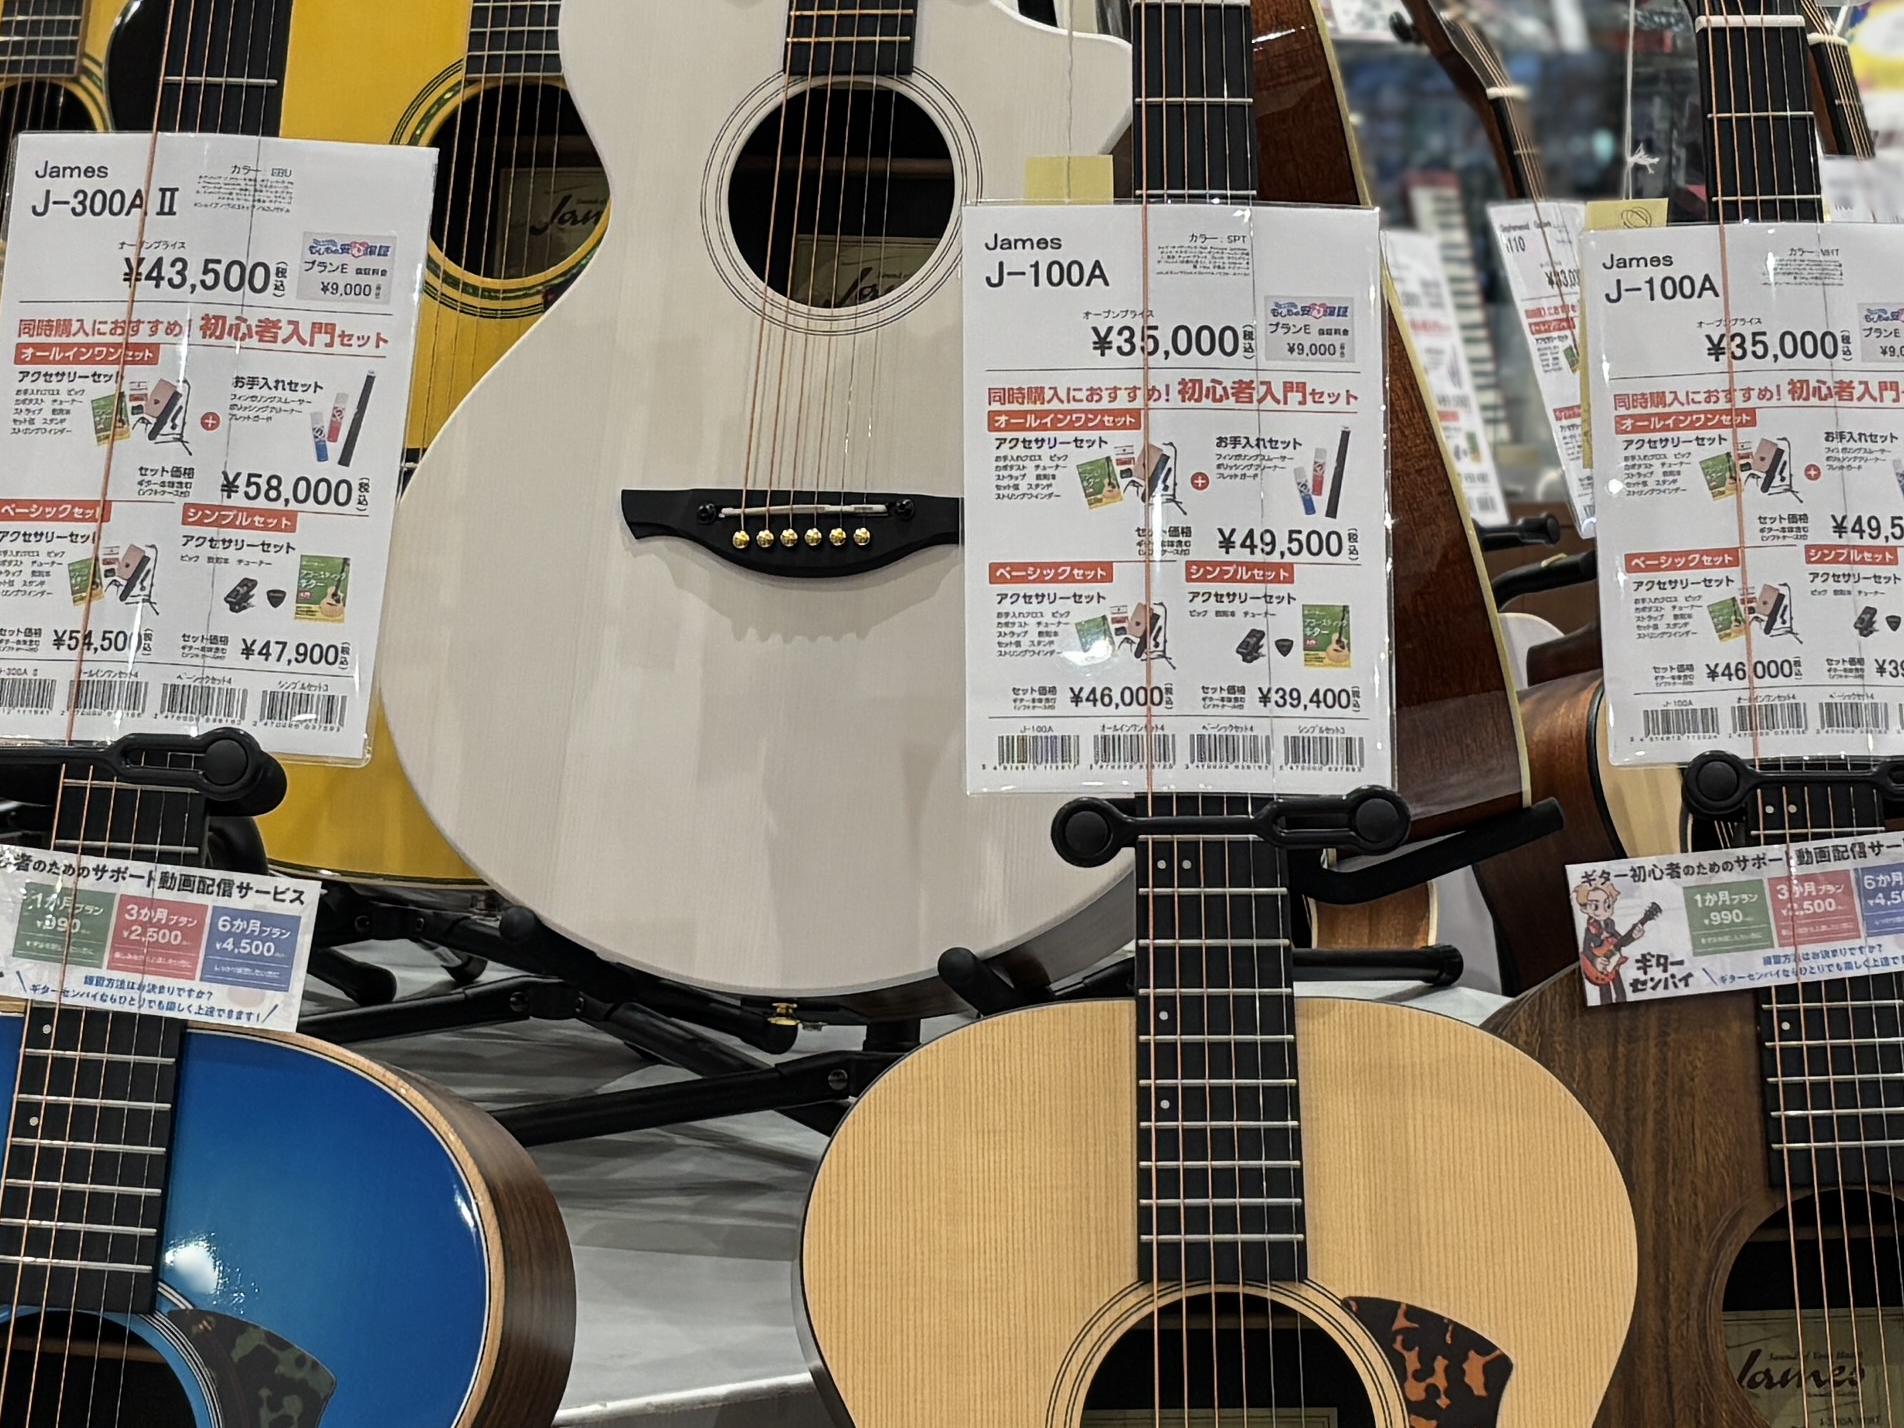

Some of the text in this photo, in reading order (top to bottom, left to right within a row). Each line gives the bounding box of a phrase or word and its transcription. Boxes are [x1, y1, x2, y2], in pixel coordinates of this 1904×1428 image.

[35, 161, 109, 179] James
[32, 189, 146, 217] J-300A
[985, 233, 1062, 251] James
[1603, 252, 1673, 270] James
[123, 257, 271, 295] ¥43,500
[986, 260, 1109, 288] J-100A
[320, 281, 372, 297] ¥9,000
[1605, 275, 1719, 304] J-100A
[1268, 322, 1311, 336] プランE
[1091, 324, 1240, 359] ¥35,000
[1286, 343, 1337, 357] ¥9,000
[1706, 330, 1838, 362] ¥35,000
[988, 378, 1358, 406] 同時購入におすすめ! 初心者入門セット
[994, 414, 1135, 428] オールインワンセット
[995, 436, 1303, 450] アクセサリーセット お手入れセット
[220, 471, 353, 507] ¥58,000
[1218, 529, 1342, 558] ¥49,500
[995, 566, 1290, 581] ベーシックセット シンプルセット
[996, 591, 1297, 605] アクセサリーセット アクセサリーセット
[241, 637, 339, 666] ¥47,900
[1070, 686, 1164, 709] ¥46,000
[1258, 687, 1351, 710] ¥39,400
